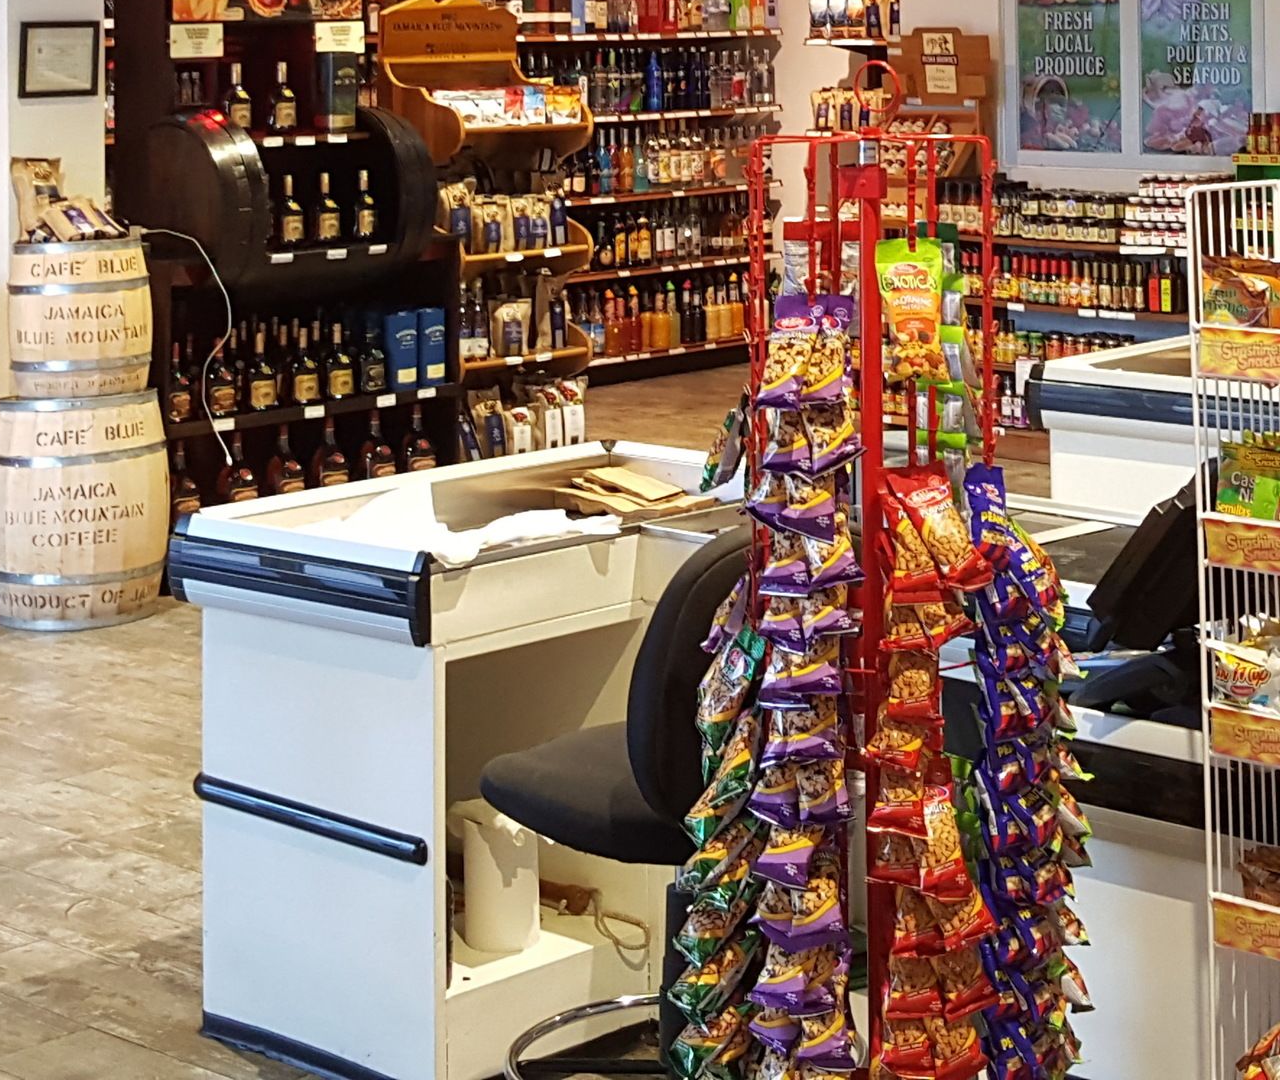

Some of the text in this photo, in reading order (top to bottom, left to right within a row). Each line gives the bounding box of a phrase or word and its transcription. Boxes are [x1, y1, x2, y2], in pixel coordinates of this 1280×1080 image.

[1043, 11, 1093, 31] FRESH
[1182, 2, 1230, 21] FRESH
[1044, 33, 1094, 53] LOCAL
[1166, 45, 1248, 65] POULTRY &
[1034, 56, 1106, 76] PRODUCE
[1173, 67, 1242, 85] SEAFOOD
[98, 256, 138, 274] BLUE
[44, 304, 126, 321] JAMAICA
[16, 329, 56, 346] BLUE
[104, 420, 145, 441] BLUE
[1230, 471, 1256, 489] Cas
[33, 481, 118, 502] JAMAICA
[4, 502, 145, 526] BLUE MOUNTAIN
[31, 528, 119, 548] COFFEE
[101, 589, 124, 605] OF
